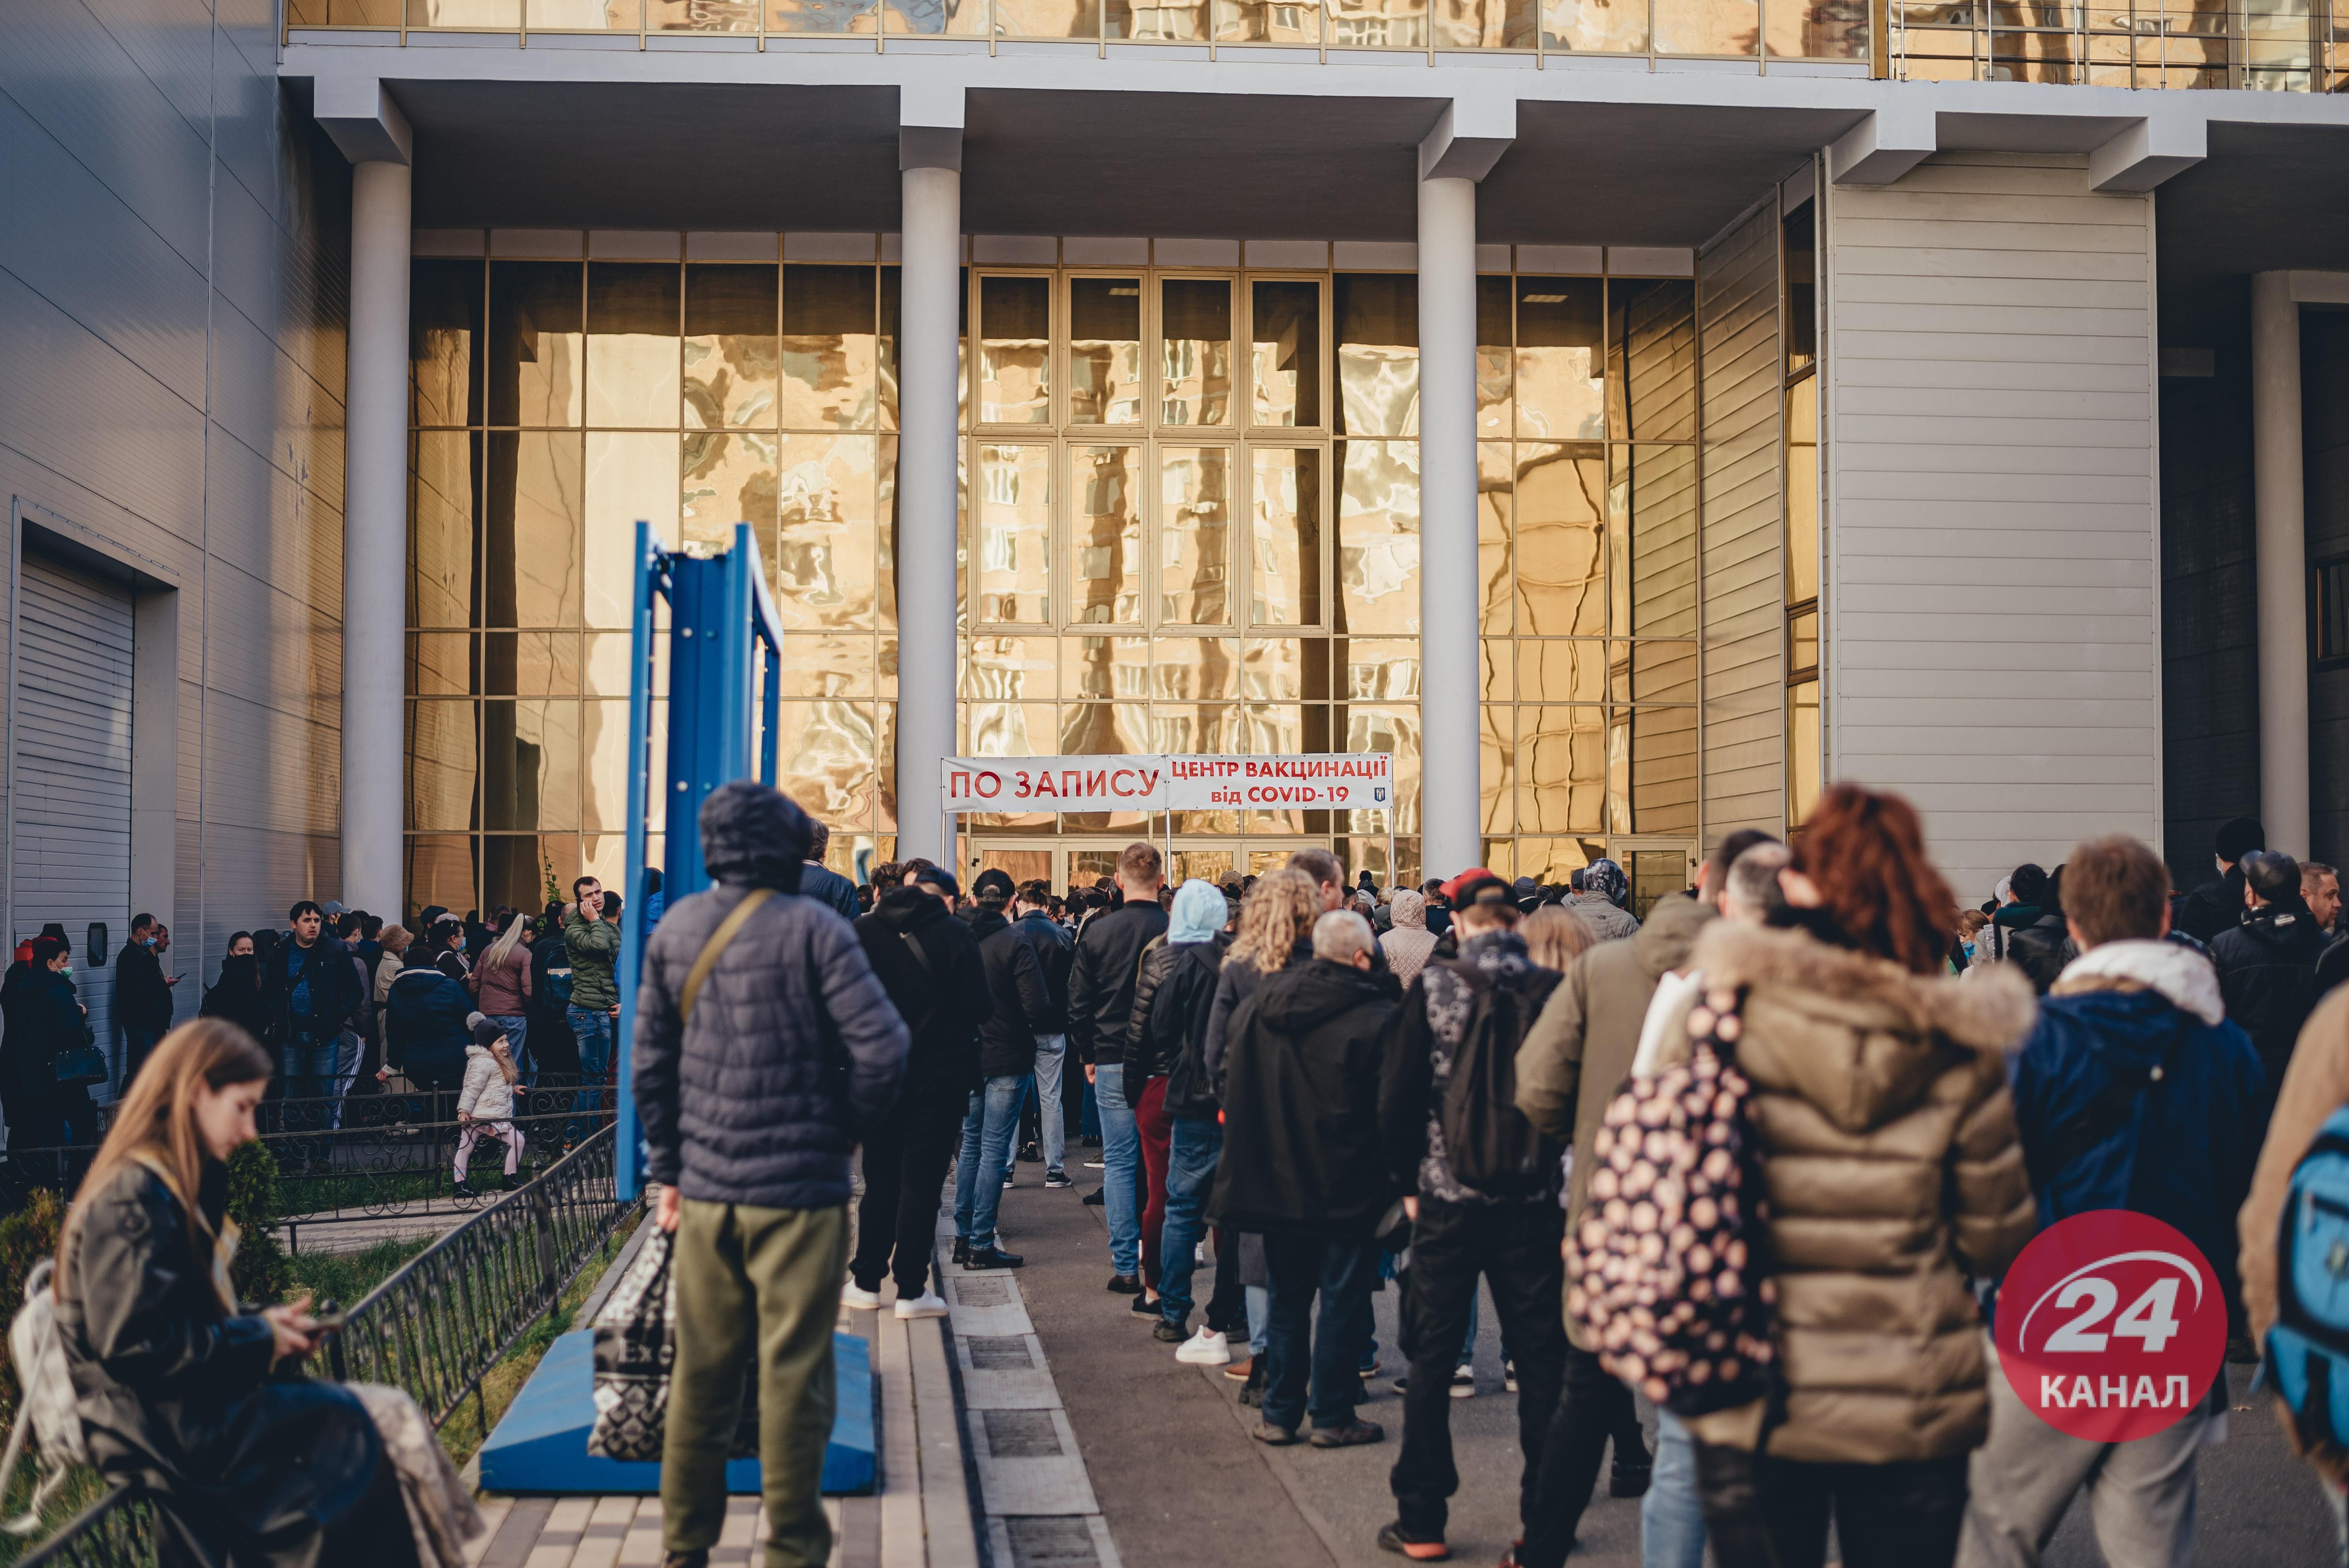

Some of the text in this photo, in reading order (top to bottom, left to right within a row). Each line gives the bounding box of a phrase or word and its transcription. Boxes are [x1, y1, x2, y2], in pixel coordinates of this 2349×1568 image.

[1171, 755, 1388, 781] ЦЕНТР ВАКЦИНАЦІЇ
[951, 769, 1159, 798] ПО ЗАПИСУ
[1211, 785, 1349, 805] від COVID-19
